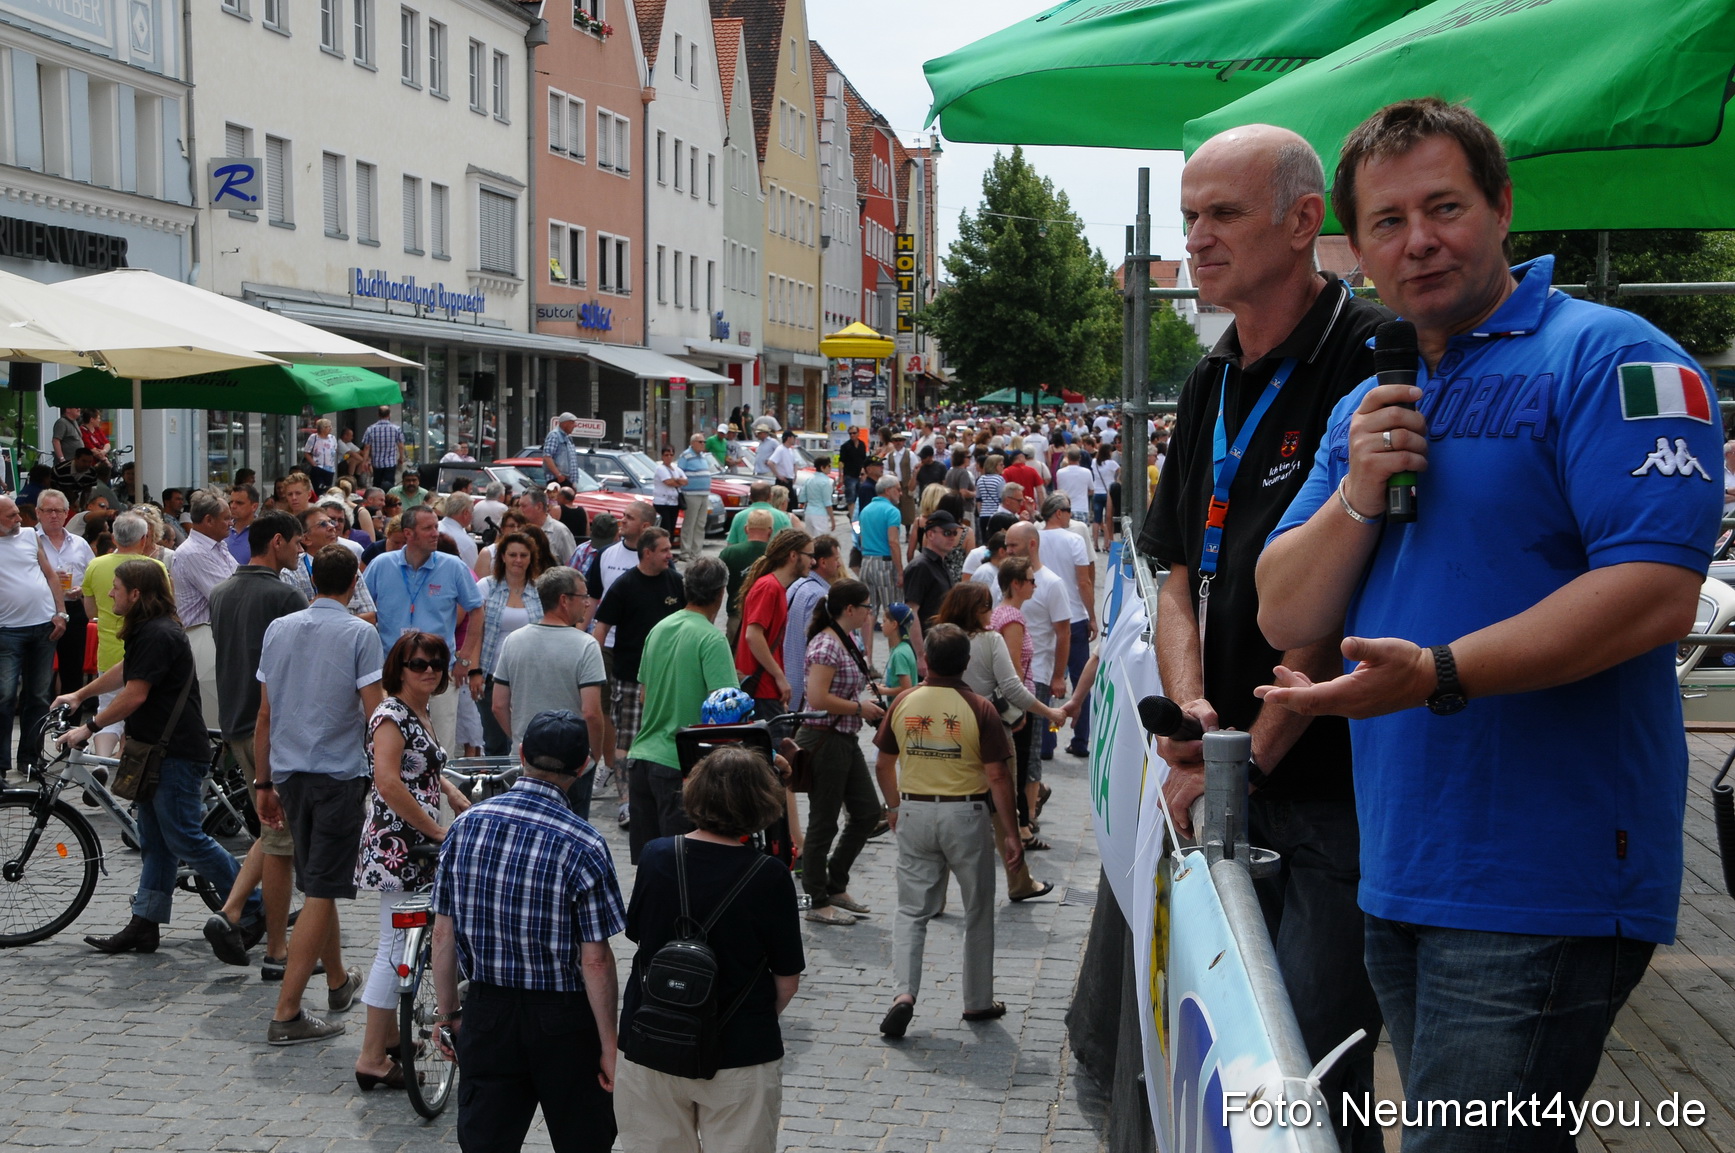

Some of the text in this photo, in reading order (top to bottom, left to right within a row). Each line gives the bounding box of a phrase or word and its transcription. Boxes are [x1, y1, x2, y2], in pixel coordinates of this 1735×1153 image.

[64, 227, 129, 270] WEBER
[356, 267, 485, 317] Buchhandlung Rupprecht
[897, 235, 914, 331] HOTEL
[537, 306, 575, 319] sutor.
